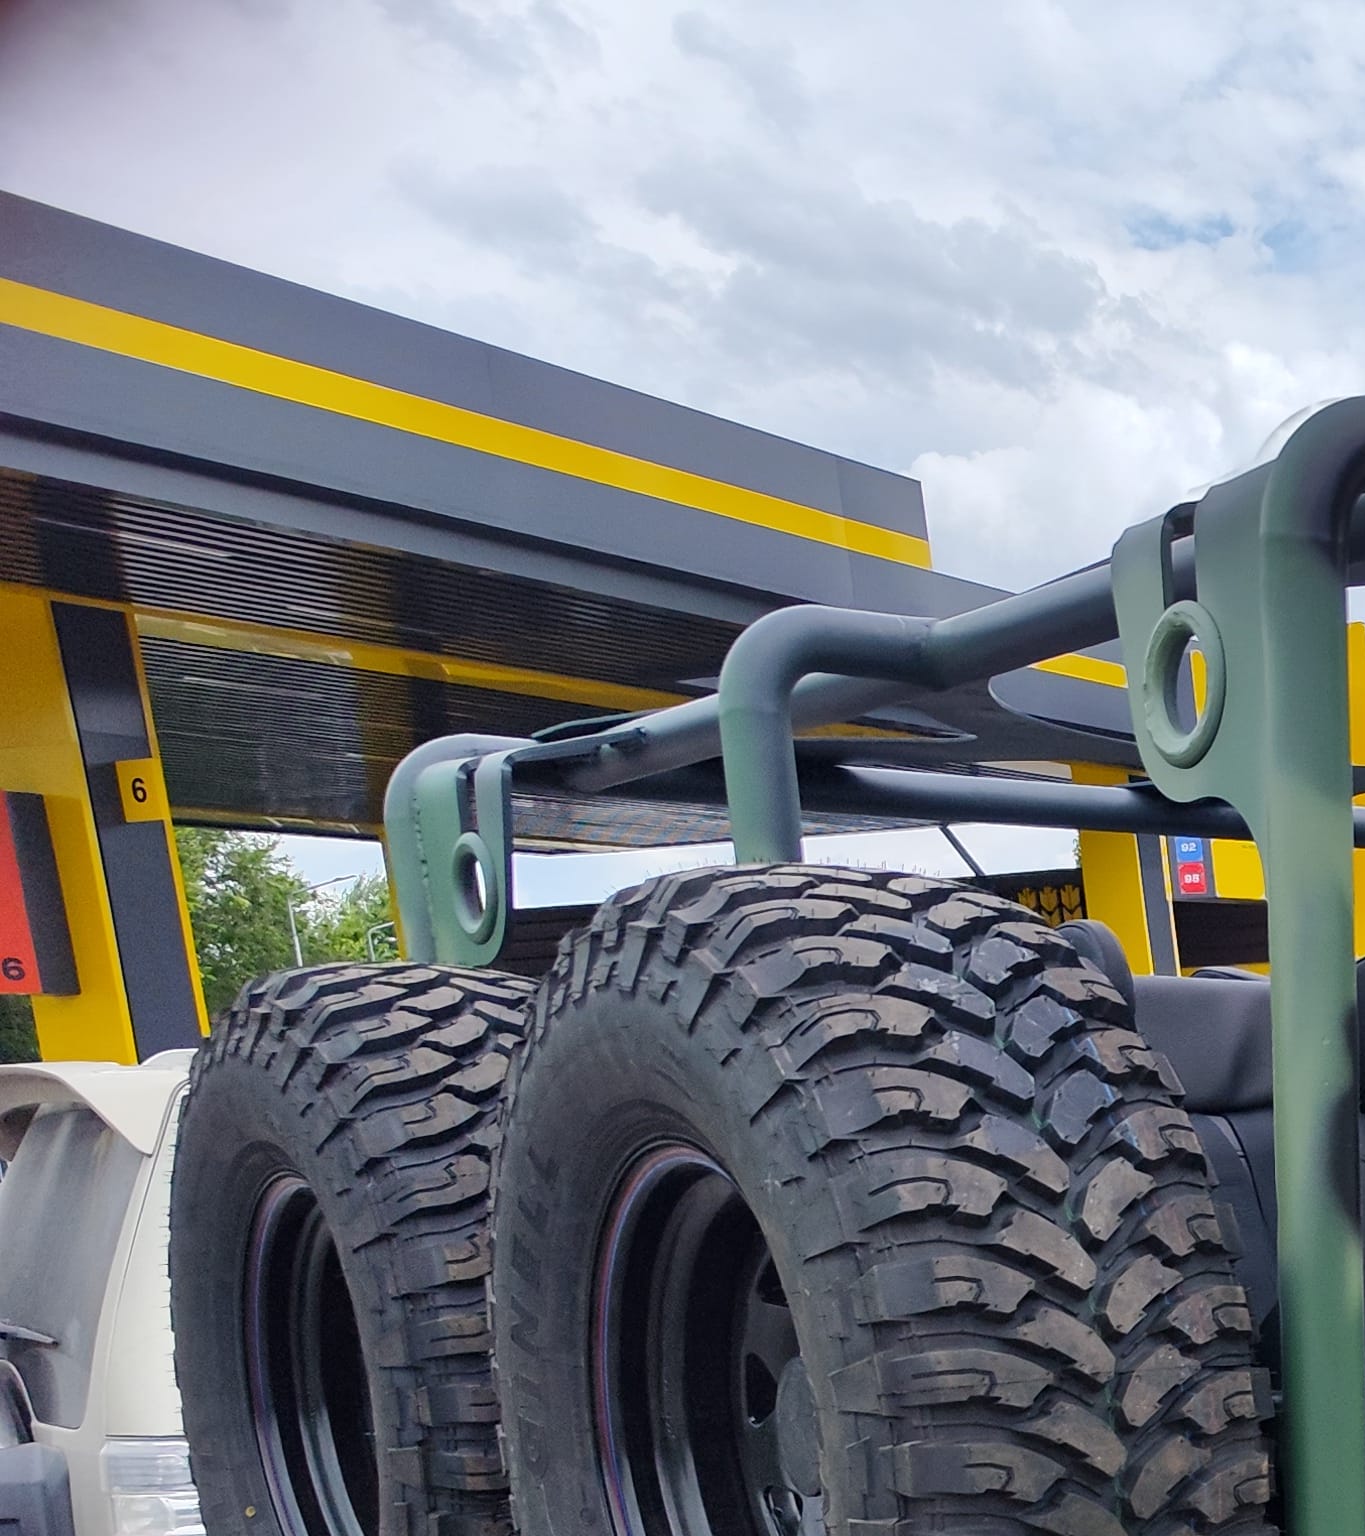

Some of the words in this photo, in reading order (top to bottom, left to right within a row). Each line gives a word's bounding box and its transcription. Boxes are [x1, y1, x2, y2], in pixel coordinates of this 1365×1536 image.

[131, 778, 148, 803] 6
[1180, 842, 1197, 852] 92
[1, 957, 25, 981] 6
